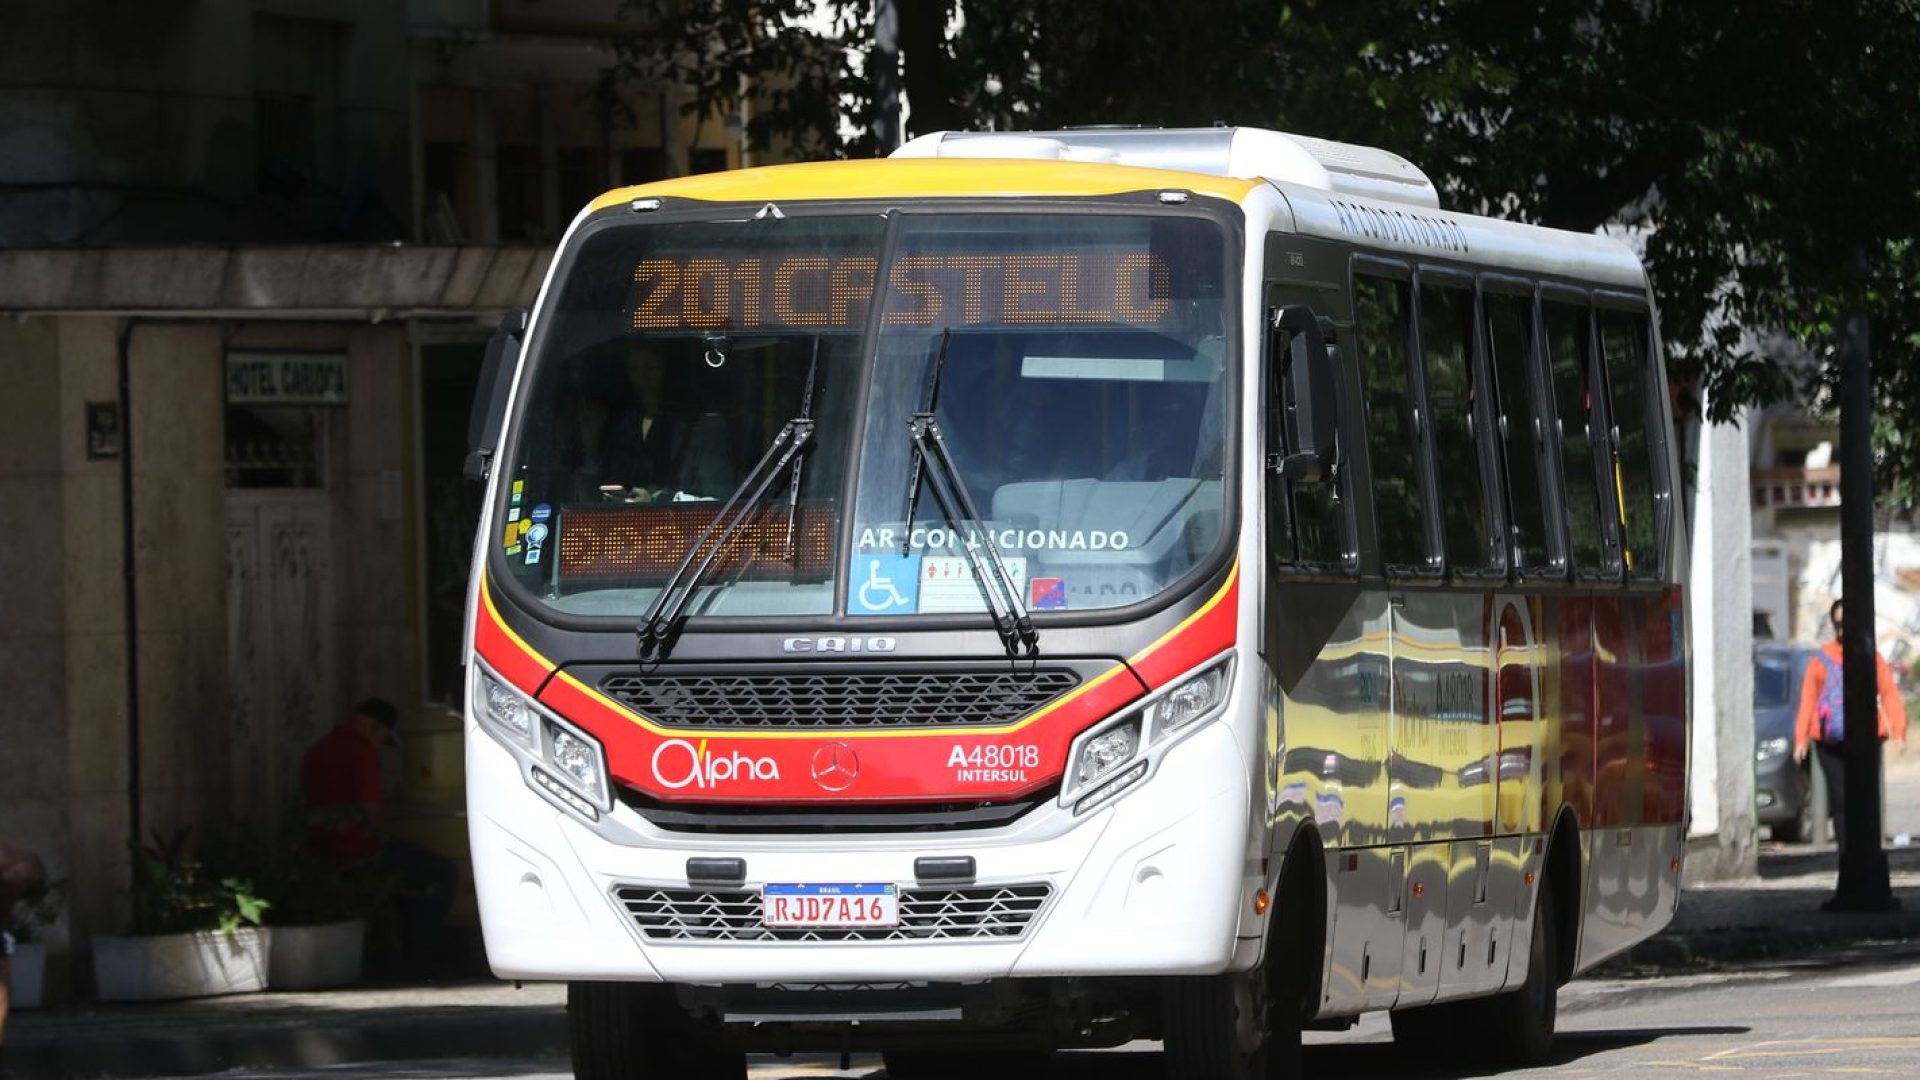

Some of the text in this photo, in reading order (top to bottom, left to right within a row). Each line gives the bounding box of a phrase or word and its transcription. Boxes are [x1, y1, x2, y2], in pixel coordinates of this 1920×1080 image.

[632, 258, 761, 328] 201
[229, 362, 276, 395] HOTEL
[859, 529, 894, 549] AR
[783, 637, 897, 653] CAIO
[947, 744, 1040, 768] A48018
[957, 769, 1028, 783] INTERSUL
[774, 897, 883, 922] RJD7A16
